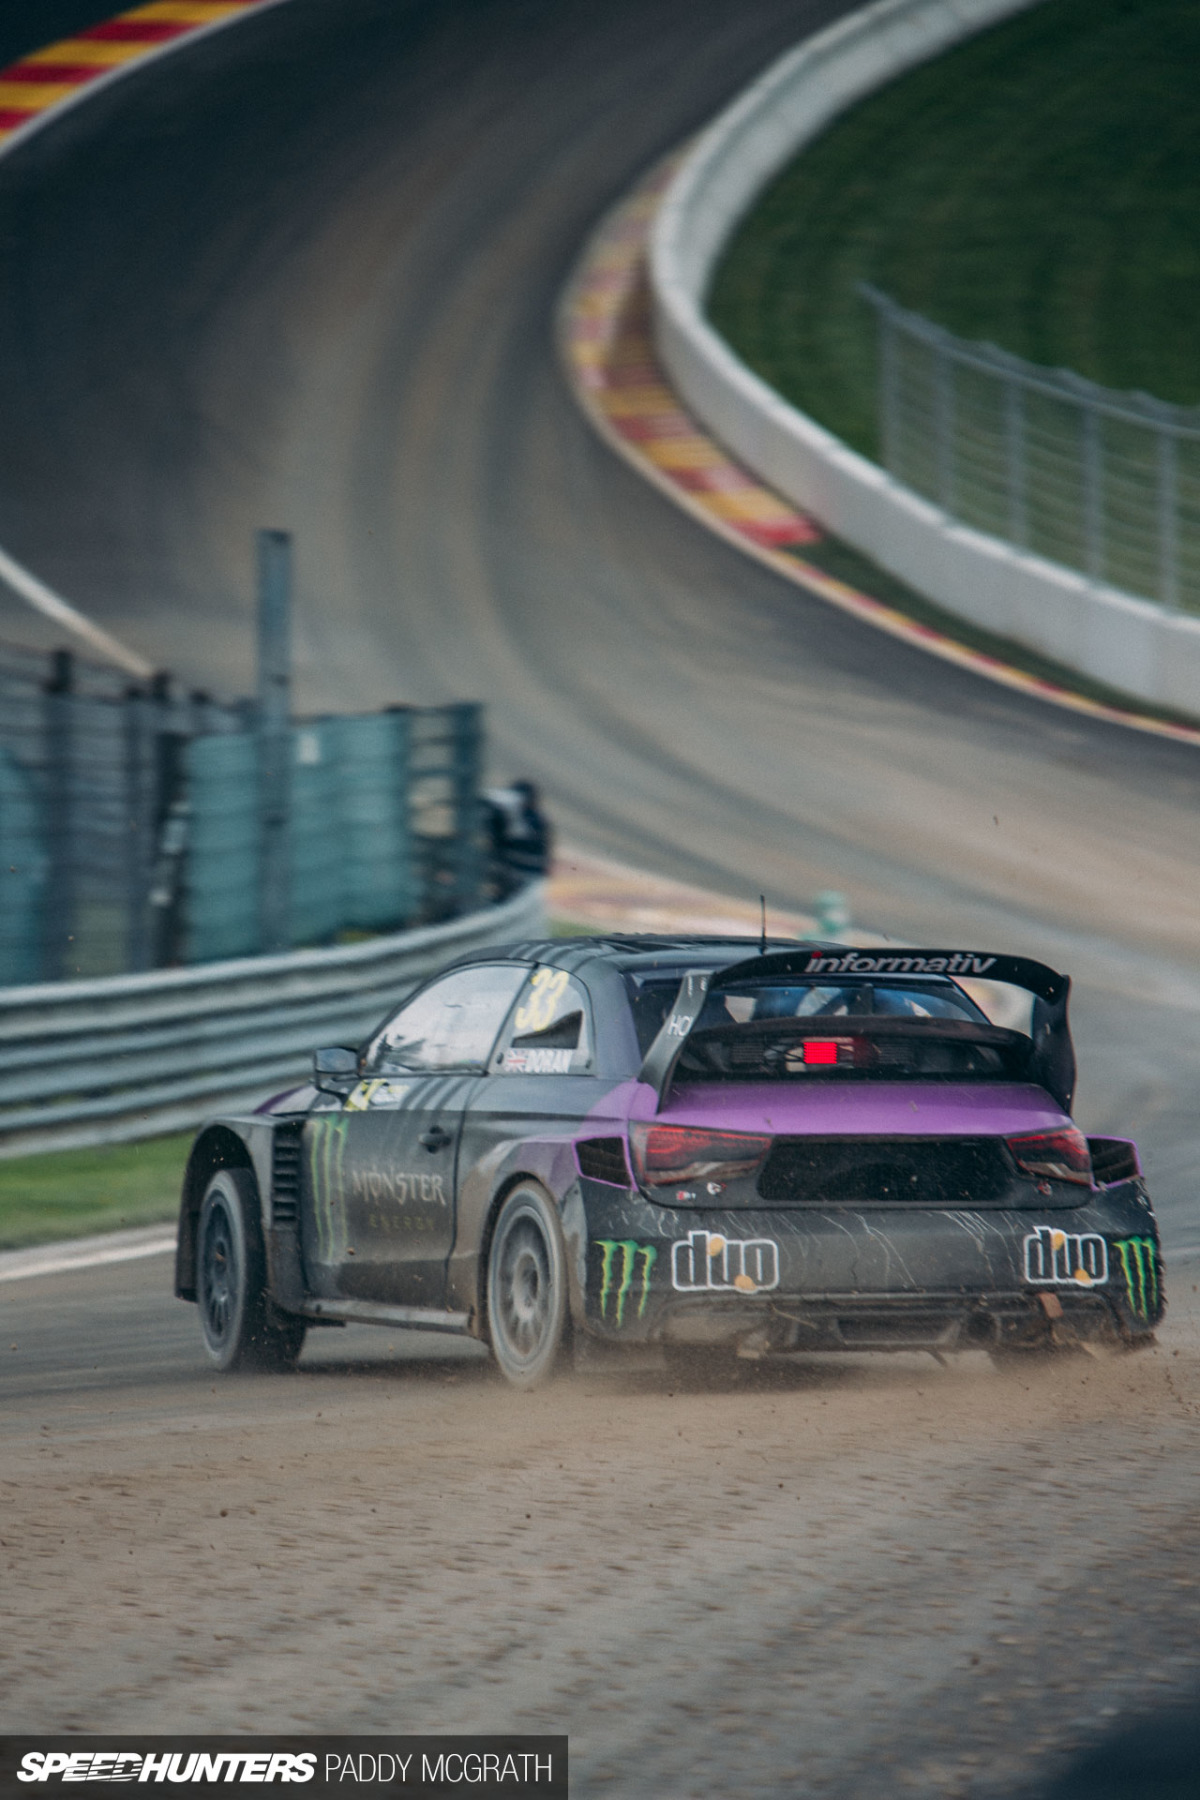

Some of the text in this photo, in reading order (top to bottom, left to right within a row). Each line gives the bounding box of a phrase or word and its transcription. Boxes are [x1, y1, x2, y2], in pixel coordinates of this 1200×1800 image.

[804, 950, 997, 974] informativ
[514, 968, 569, 1032] 33
[351, 1163, 447, 1206] MONSTER
